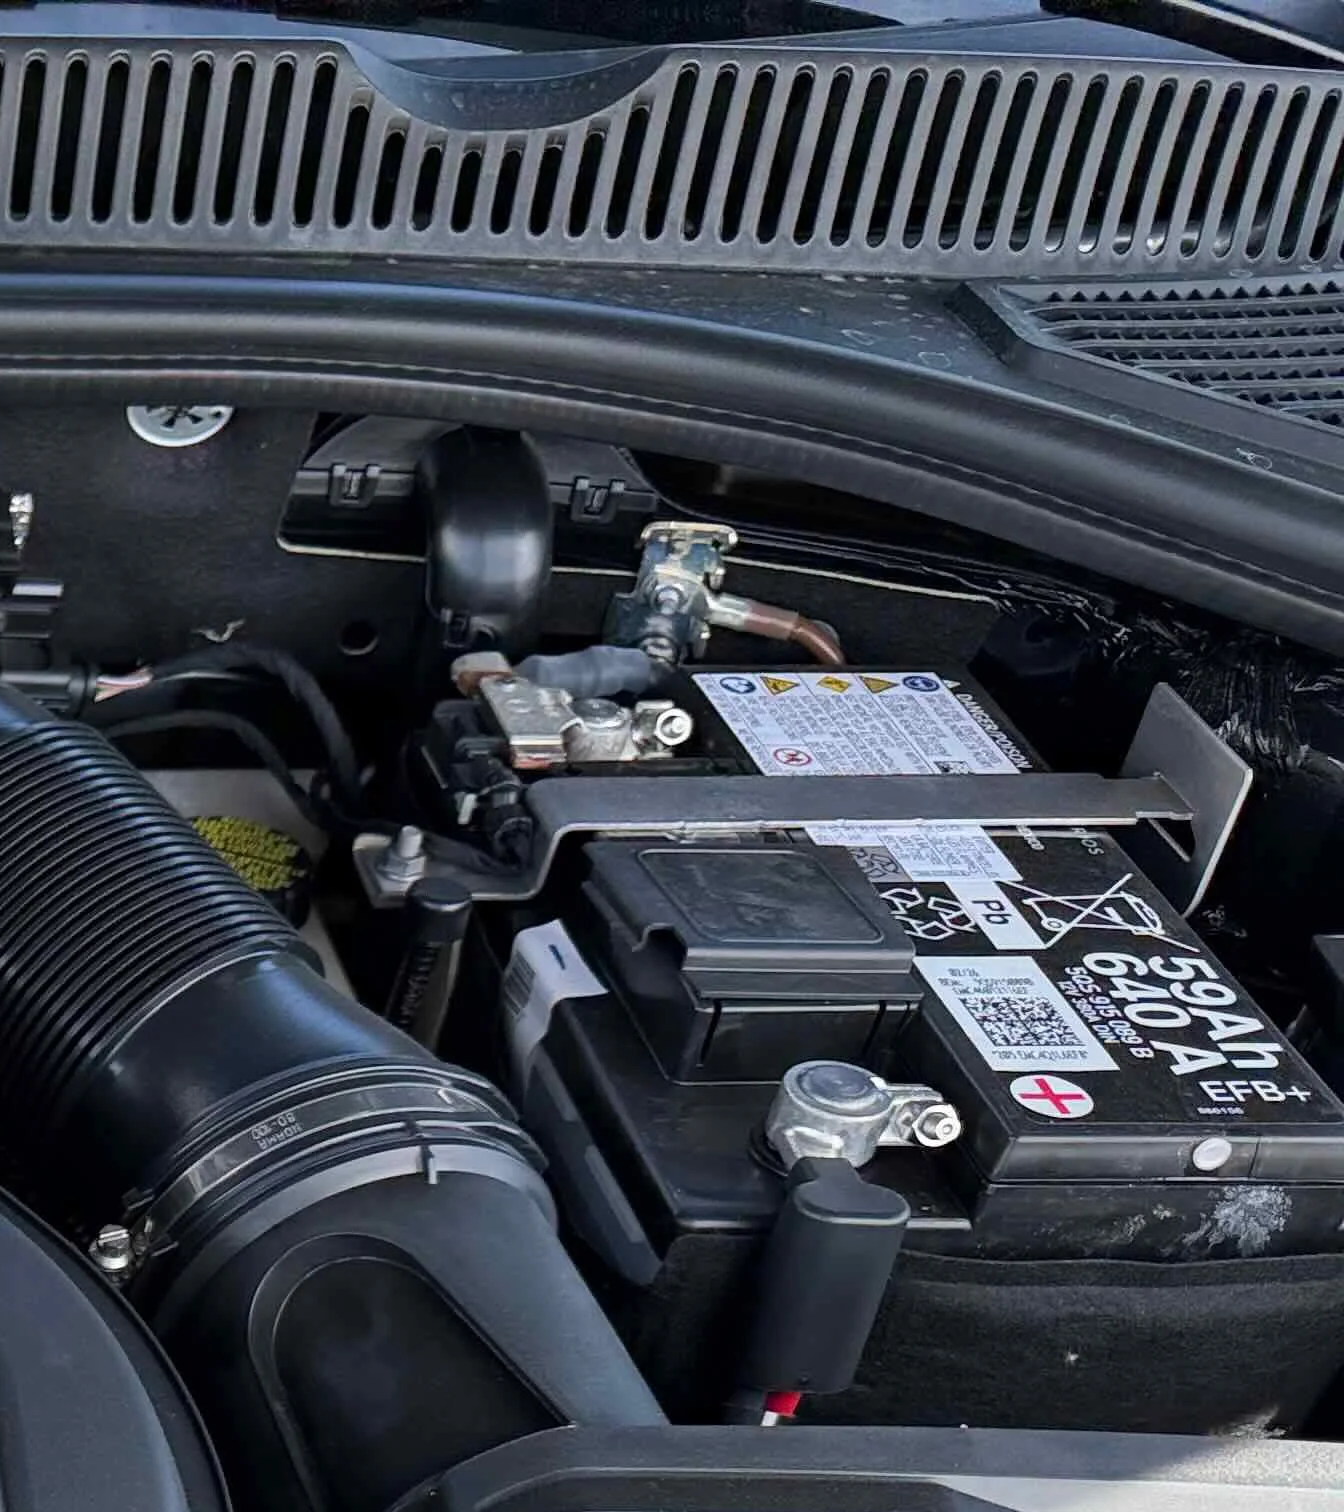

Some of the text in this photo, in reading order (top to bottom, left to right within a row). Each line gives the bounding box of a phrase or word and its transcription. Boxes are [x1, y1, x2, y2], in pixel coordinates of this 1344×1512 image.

[958, 692, 1031, 769] DANGER/POISON
[971, 899, 1010, 925] Pb
[1064, 966, 1102, 993] 5QS
[1088, 995, 1123, 1018] 915
[1108, 1019, 1143, 1044] 089
[1082, 951, 1190, 1029] 640
[1151, 1040, 1232, 1076] A
[1148, 954, 1287, 1070] 59Ah
[1199, 1079, 1313, 1104] EFB+
